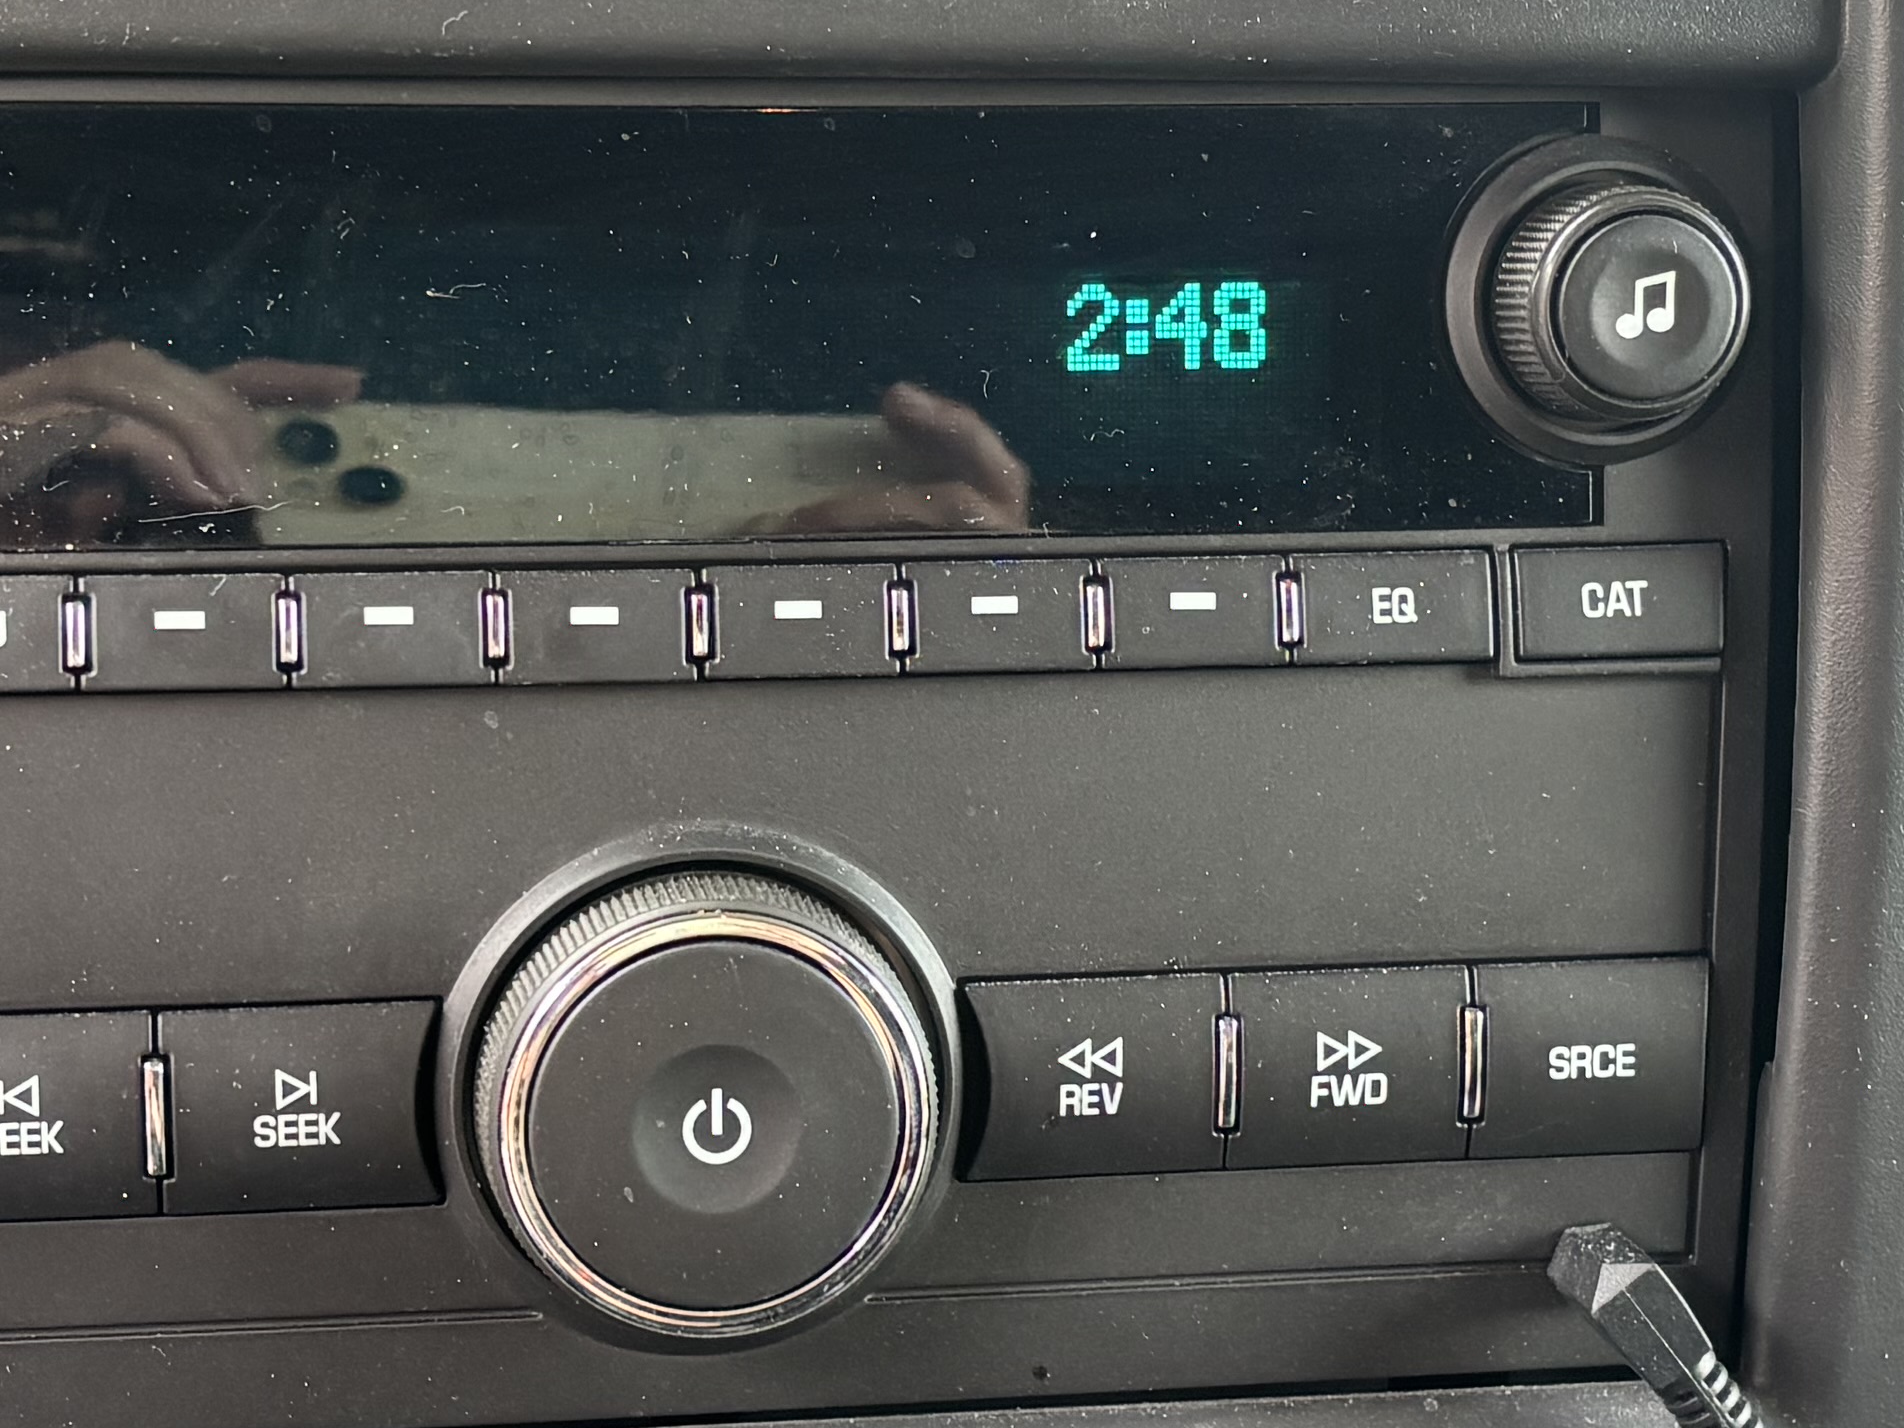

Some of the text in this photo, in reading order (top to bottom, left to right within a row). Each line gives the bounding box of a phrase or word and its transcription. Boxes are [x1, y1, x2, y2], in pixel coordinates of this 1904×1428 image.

[1066, 282, 1266, 371] 2:48
[1371, 587, 1418, 623] EQ
[1581, 580, 1648, 618] CAT
[1549, 1043, 1636, 1080] SRCE
[1059, 1083, 1124, 1117] REV
[1310, 1072, 1388, 1108] FWD
[253, 1111, 341, 1148] SEEK
